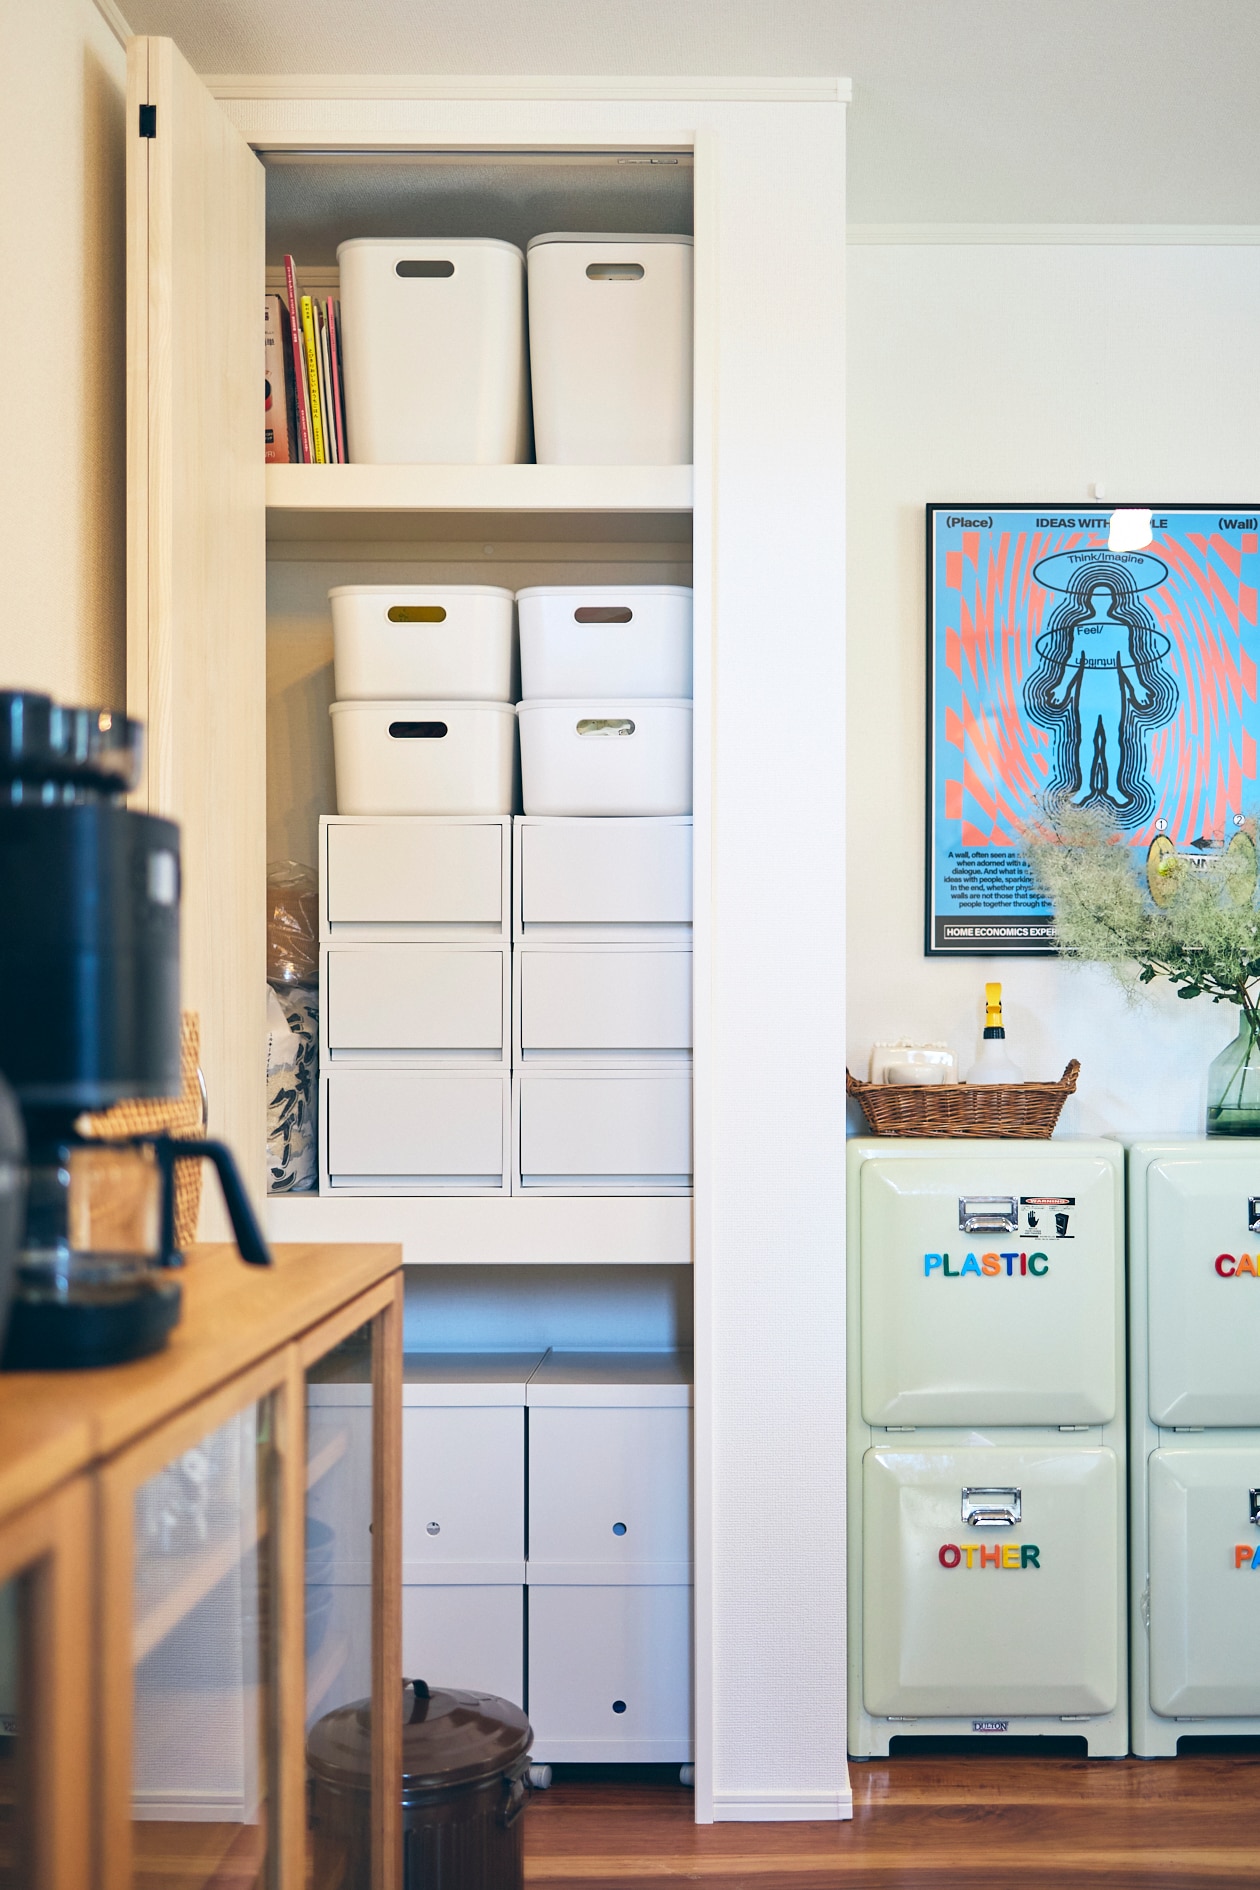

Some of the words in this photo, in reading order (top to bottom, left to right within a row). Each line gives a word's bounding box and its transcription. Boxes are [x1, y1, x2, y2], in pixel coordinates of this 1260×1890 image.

[946, 515, 993, 528] (Place)
[1036, 518, 1076, 528] IDEAS
[1218, 517, 1258, 530] (Wall)
[1067, 552, 1144, 565] Think/Imagine
[1076, 625, 1104, 635] Feel/
[952, 868, 983, 876] dialogue.
[983, 868, 998, 876] And
[999, 868, 1016, 876] what
[1017, 868, 1023, 876] is
[944, 876, 962, 884] ideas
[963, 876, 978, 884] with
[979, 876, 1003, 884] people,
[950, 884, 957, 892] In
[958, 884, 970, 892] the
[970, 884, 985, 892] end,
[986, 884, 1014, 892] whether
[959, 901, 982, 909] people
[983, 901, 1012, 909] together
[1013, 901, 1040, 909] through
[1041, 901, 1052, 909] the
[946, 928, 974, 936] HOME
[975, 928, 1029, 936] ECONOMICS
[924, 1252, 1049, 1277] PLASTIC
[1214, 1253, 1260, 1278] CA
[938, 1543, 1040, 1569] OTHER
[974, 1721, 1007, 1731] DULTON
